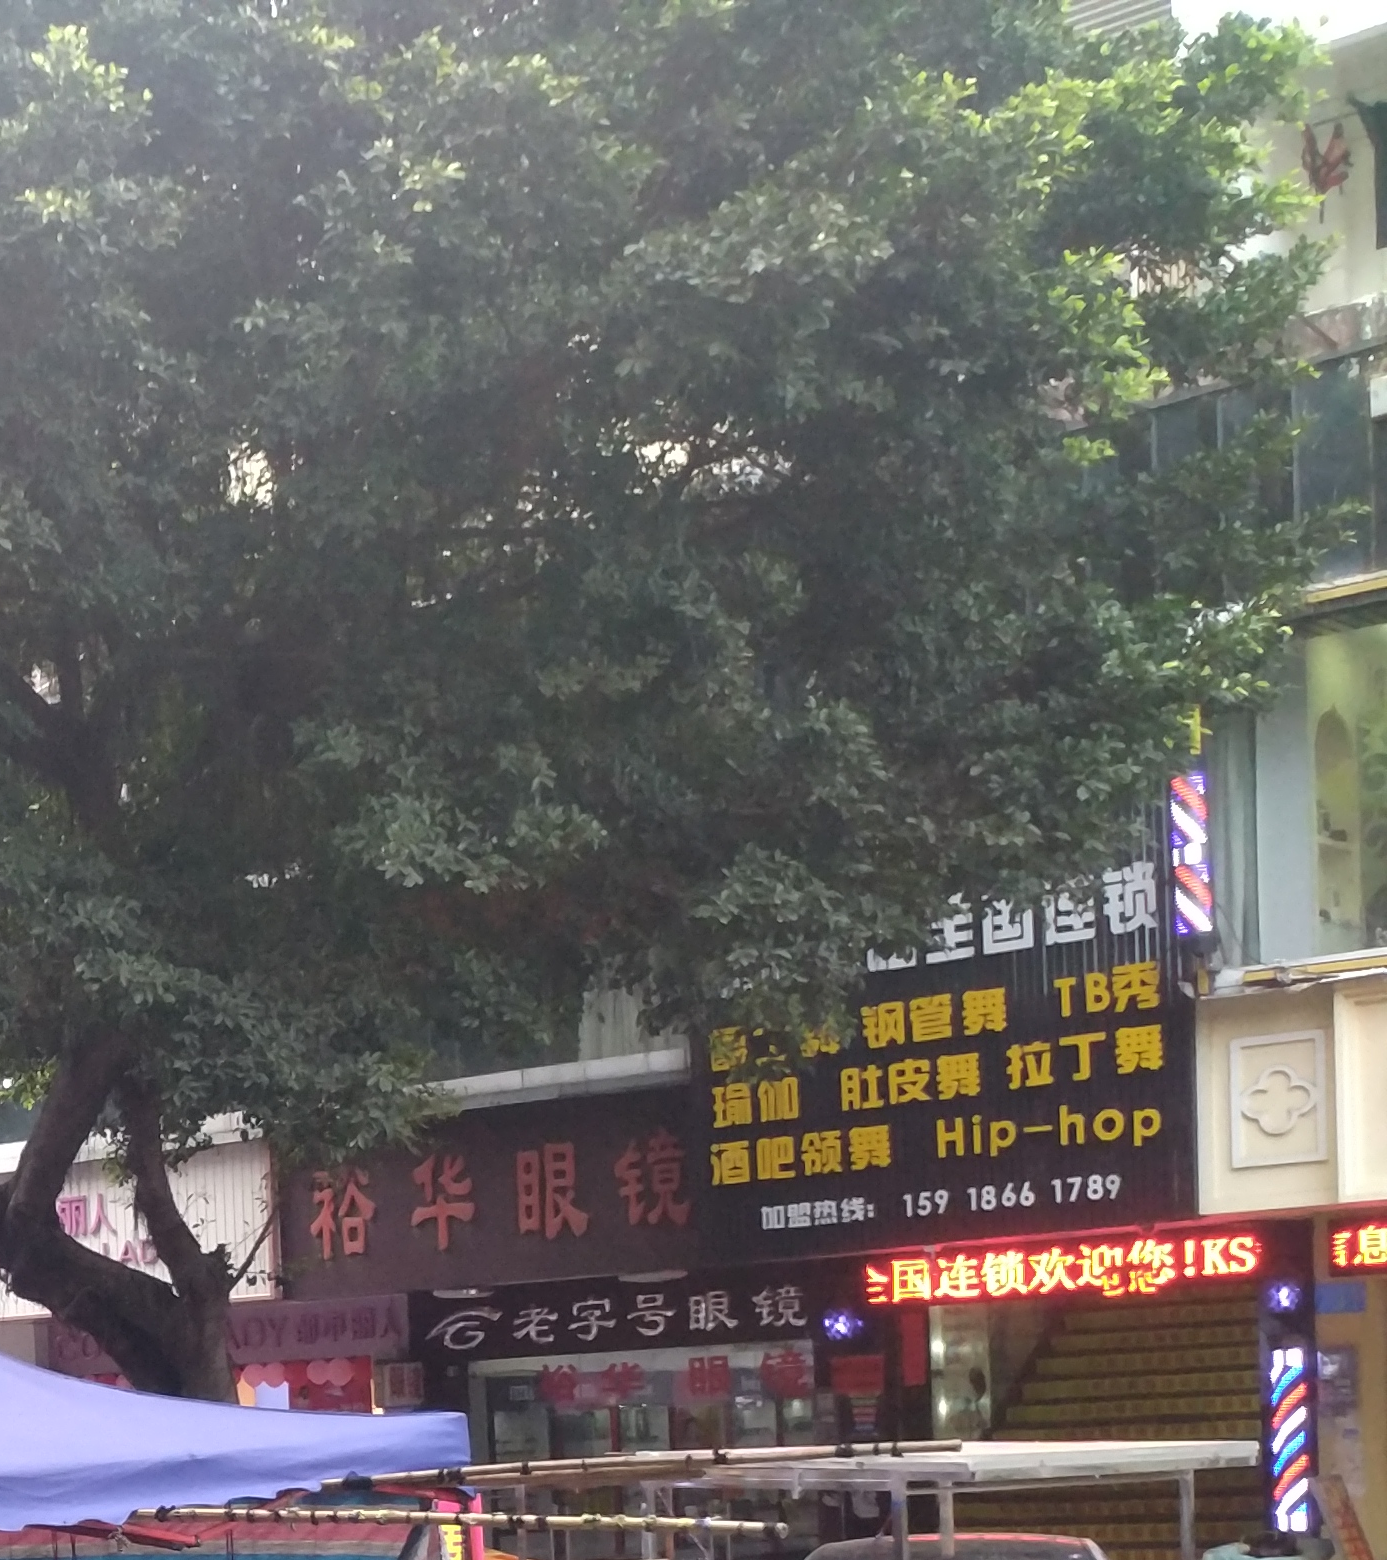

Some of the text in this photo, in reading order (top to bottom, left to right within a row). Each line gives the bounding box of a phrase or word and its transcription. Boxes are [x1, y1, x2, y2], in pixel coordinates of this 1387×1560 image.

[861, 987, 1007, 1048] 钢管舞
[712, 1024, 1164, 1128] 瑜伽 肚皮舞 拉丁舞
[710, 1104, 1163, 1186] 酒吧领舞 Hip-hop
[309, 1128, 694, 1260] 裕华眼镜
[903, 1190, 949, 1218] 159
[967, 1181, 1035, 1212] 1866
[1051, 1173, 1121, 1205] 1789
[512, 1285, 809, 1346] 老字号眼镜
